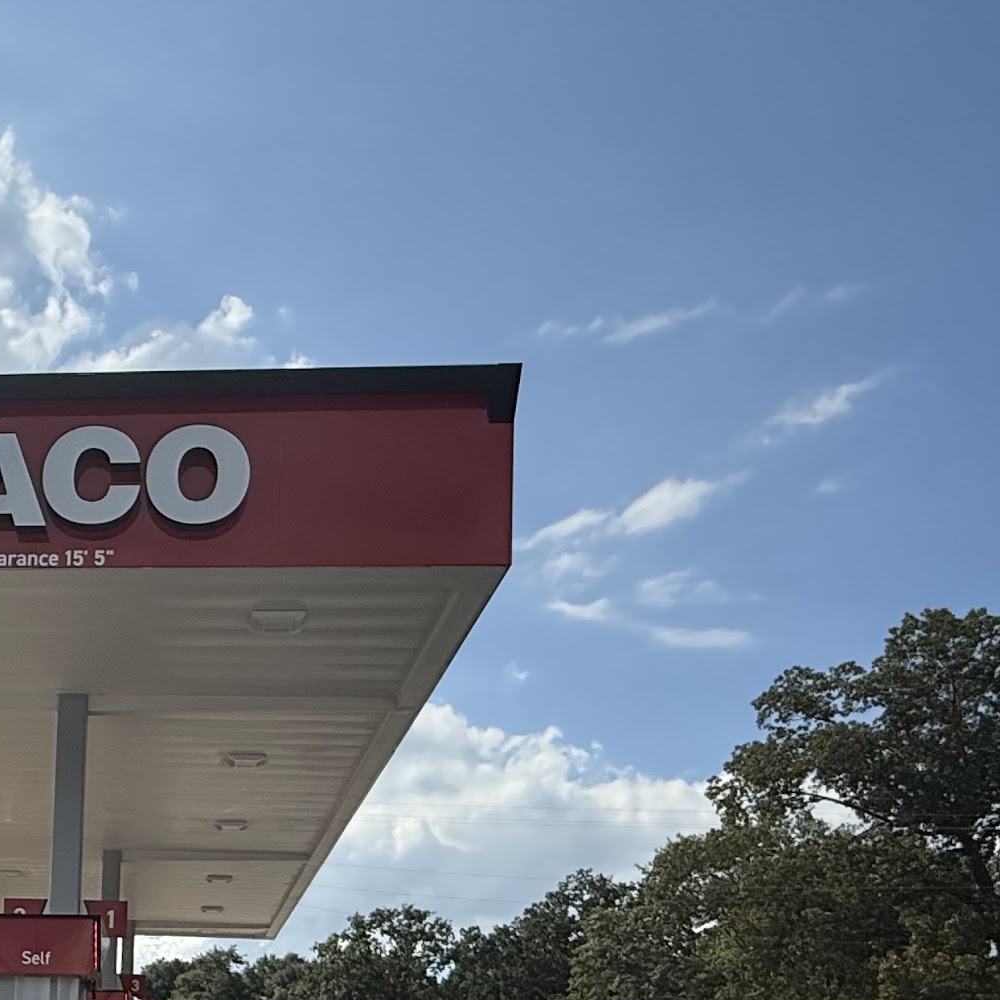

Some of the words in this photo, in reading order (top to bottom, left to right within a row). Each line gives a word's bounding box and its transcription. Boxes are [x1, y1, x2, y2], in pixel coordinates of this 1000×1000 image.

[106, 910, 115, 929] 1
[21, 950, 51, 965] Self
[131, 980, 140, 992] 3
